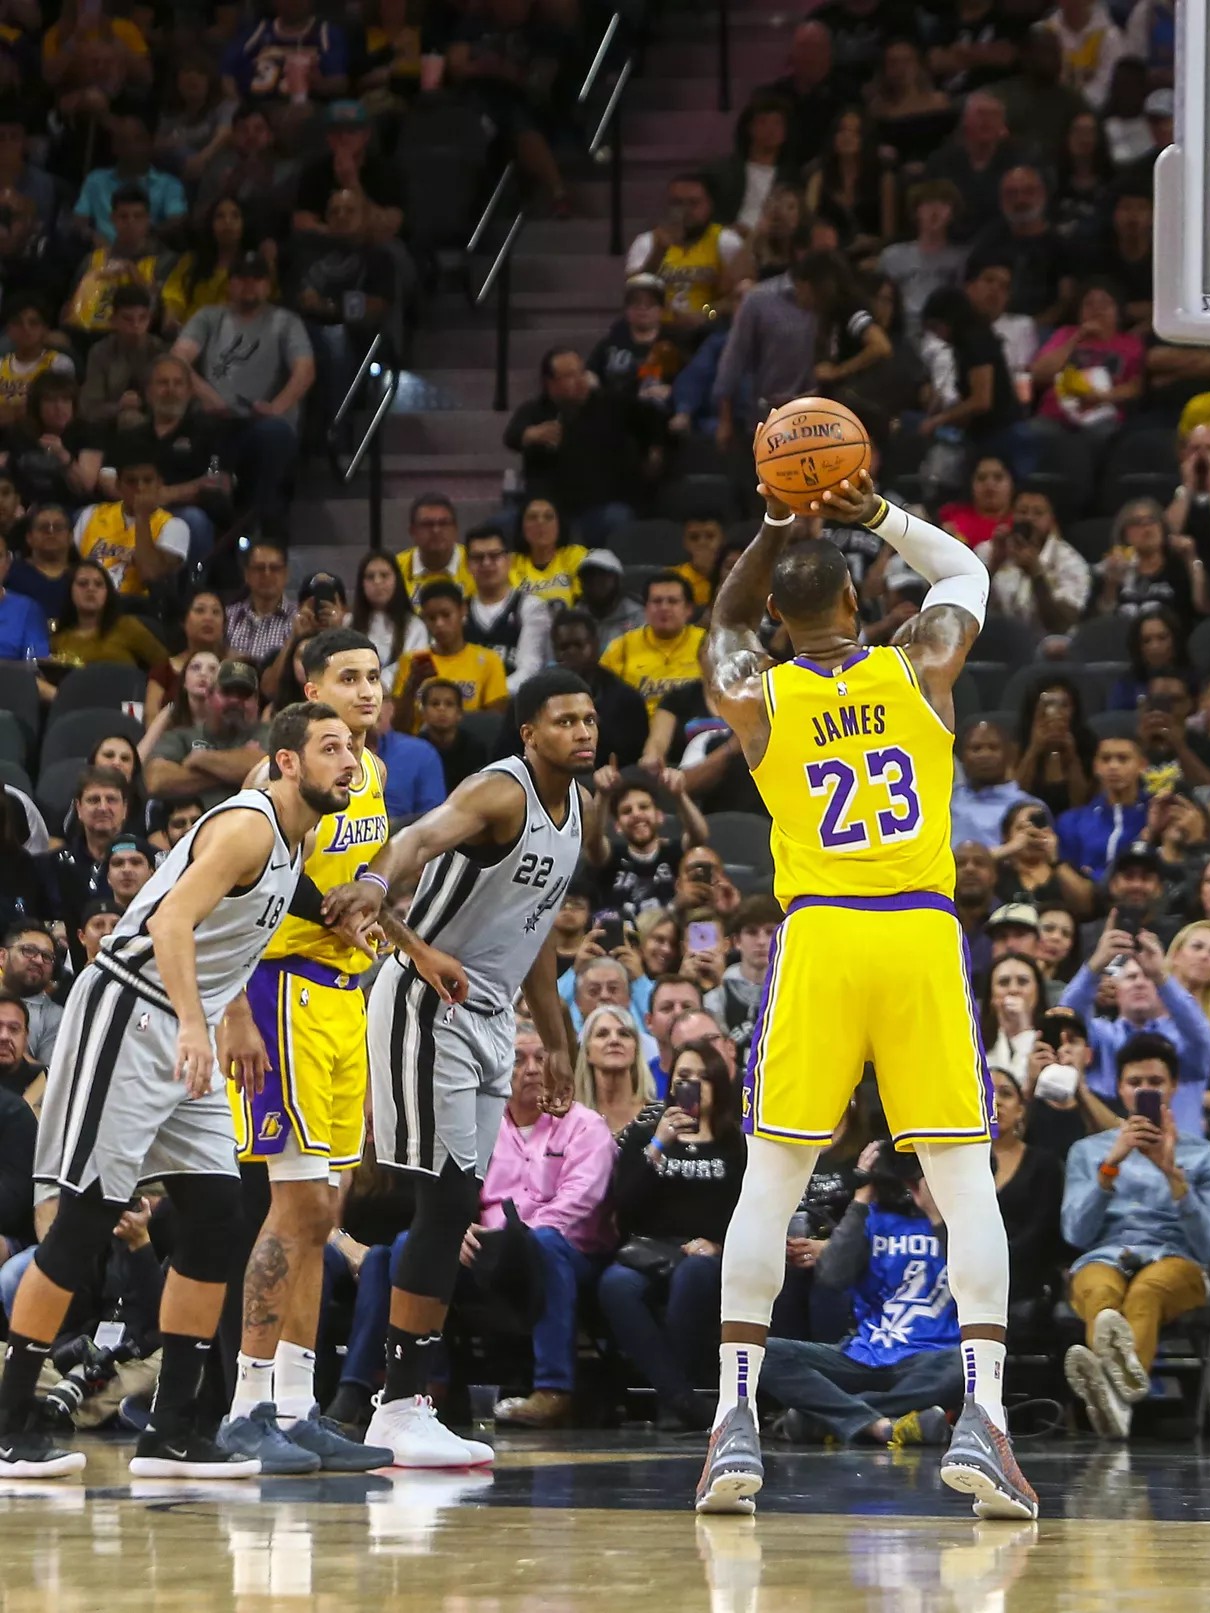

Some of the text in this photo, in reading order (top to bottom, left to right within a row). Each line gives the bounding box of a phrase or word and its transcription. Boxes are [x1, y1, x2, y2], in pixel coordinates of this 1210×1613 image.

[767, 422, 844, 454] SPALDING
[812, 704, 885, 747] JAMES
[804, 744, 924, 853] 23
[512, 852, 555, 888] 22
[255, 894, 285, 929] 18
